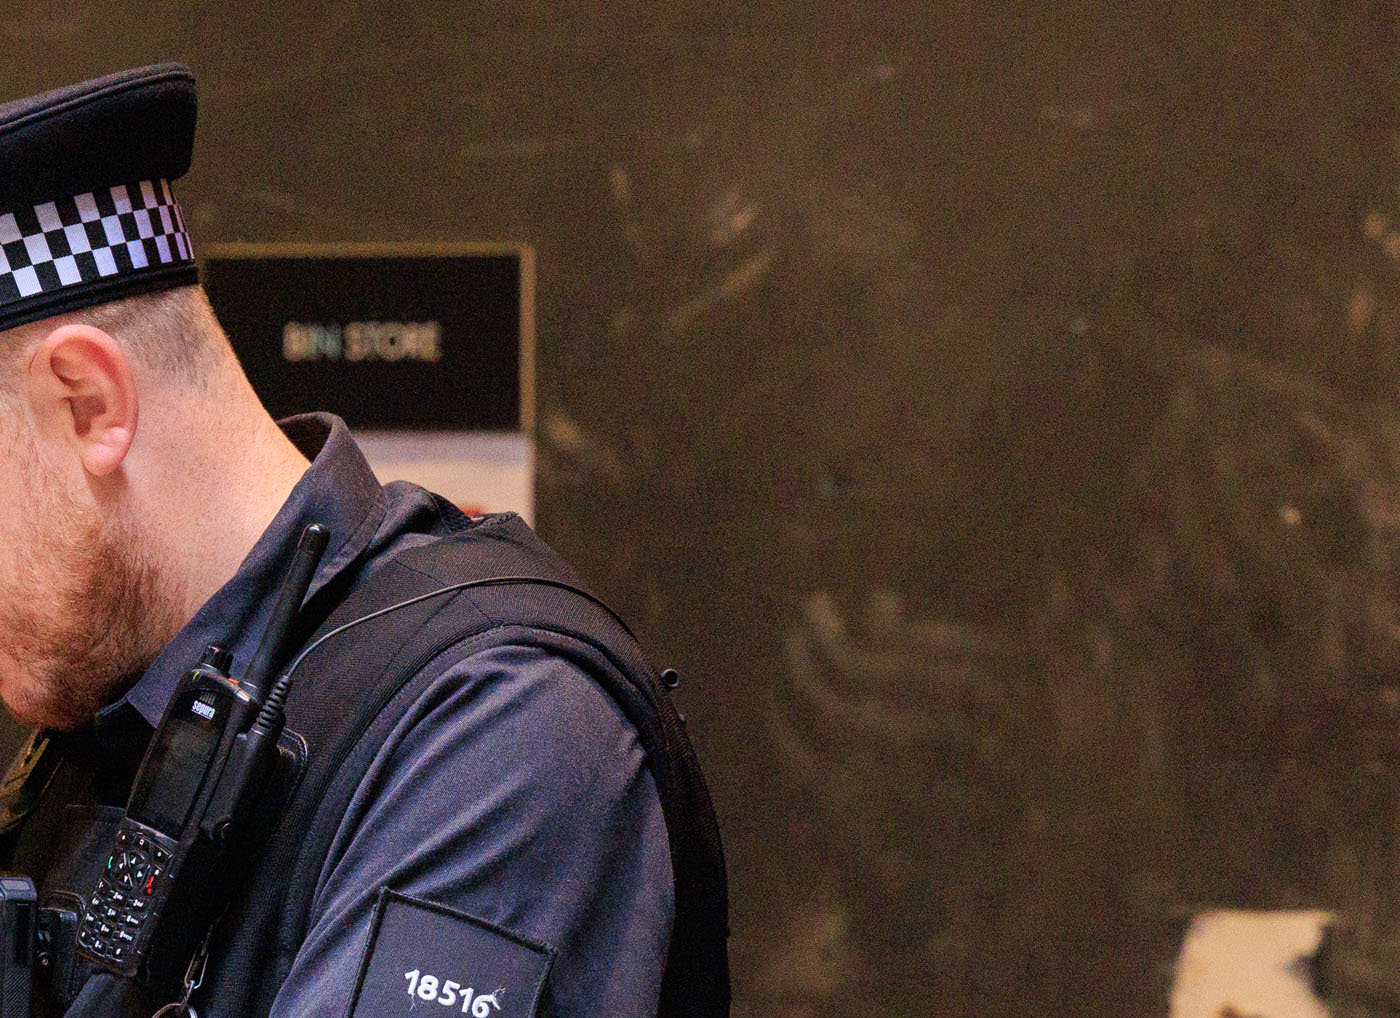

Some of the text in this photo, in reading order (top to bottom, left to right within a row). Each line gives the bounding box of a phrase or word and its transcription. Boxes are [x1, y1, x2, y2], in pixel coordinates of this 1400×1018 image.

[283, 320, 441, 361] BIN STORE
[404, 969, 493, 1018] 18516
